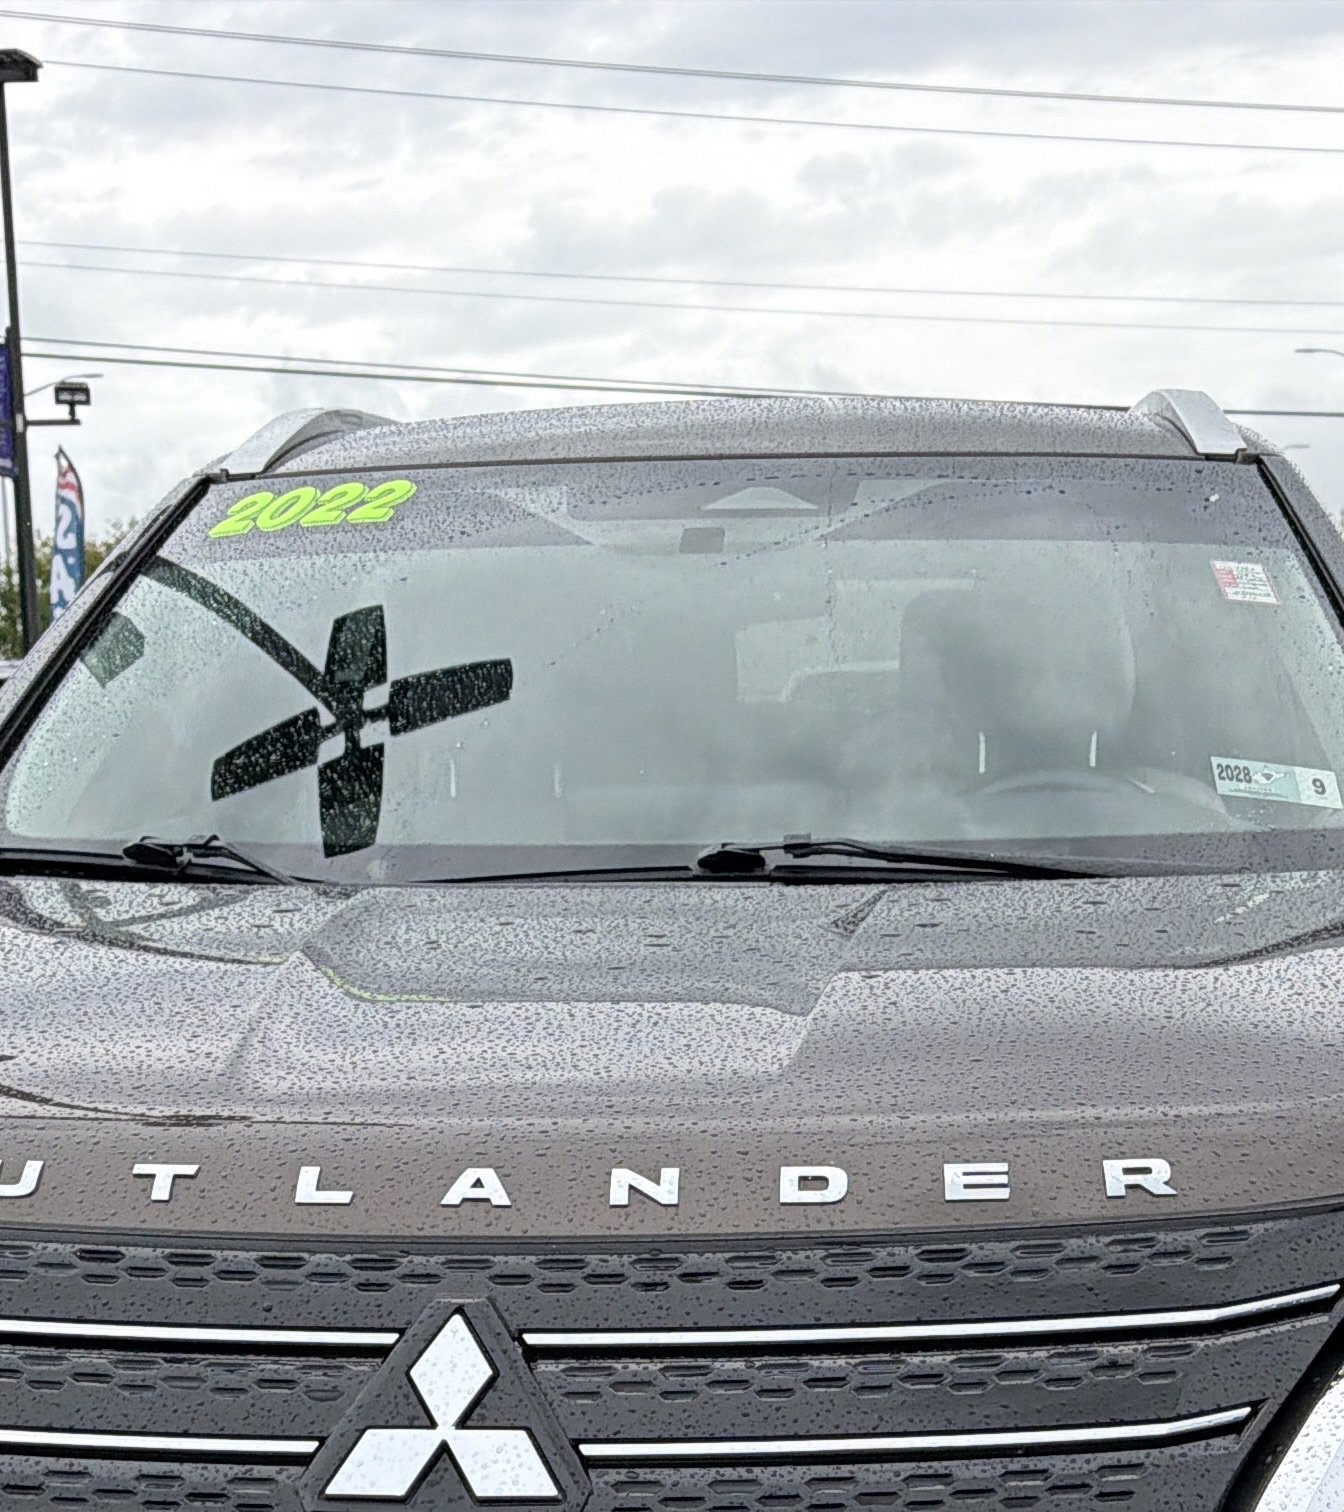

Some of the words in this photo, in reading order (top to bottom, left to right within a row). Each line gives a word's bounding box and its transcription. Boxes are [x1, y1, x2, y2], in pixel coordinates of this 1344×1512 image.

[208, 479, 418, 538] 2022
[1216, 762, 1253, 783] 2028
[1311, 777, 1327, 796] 9
